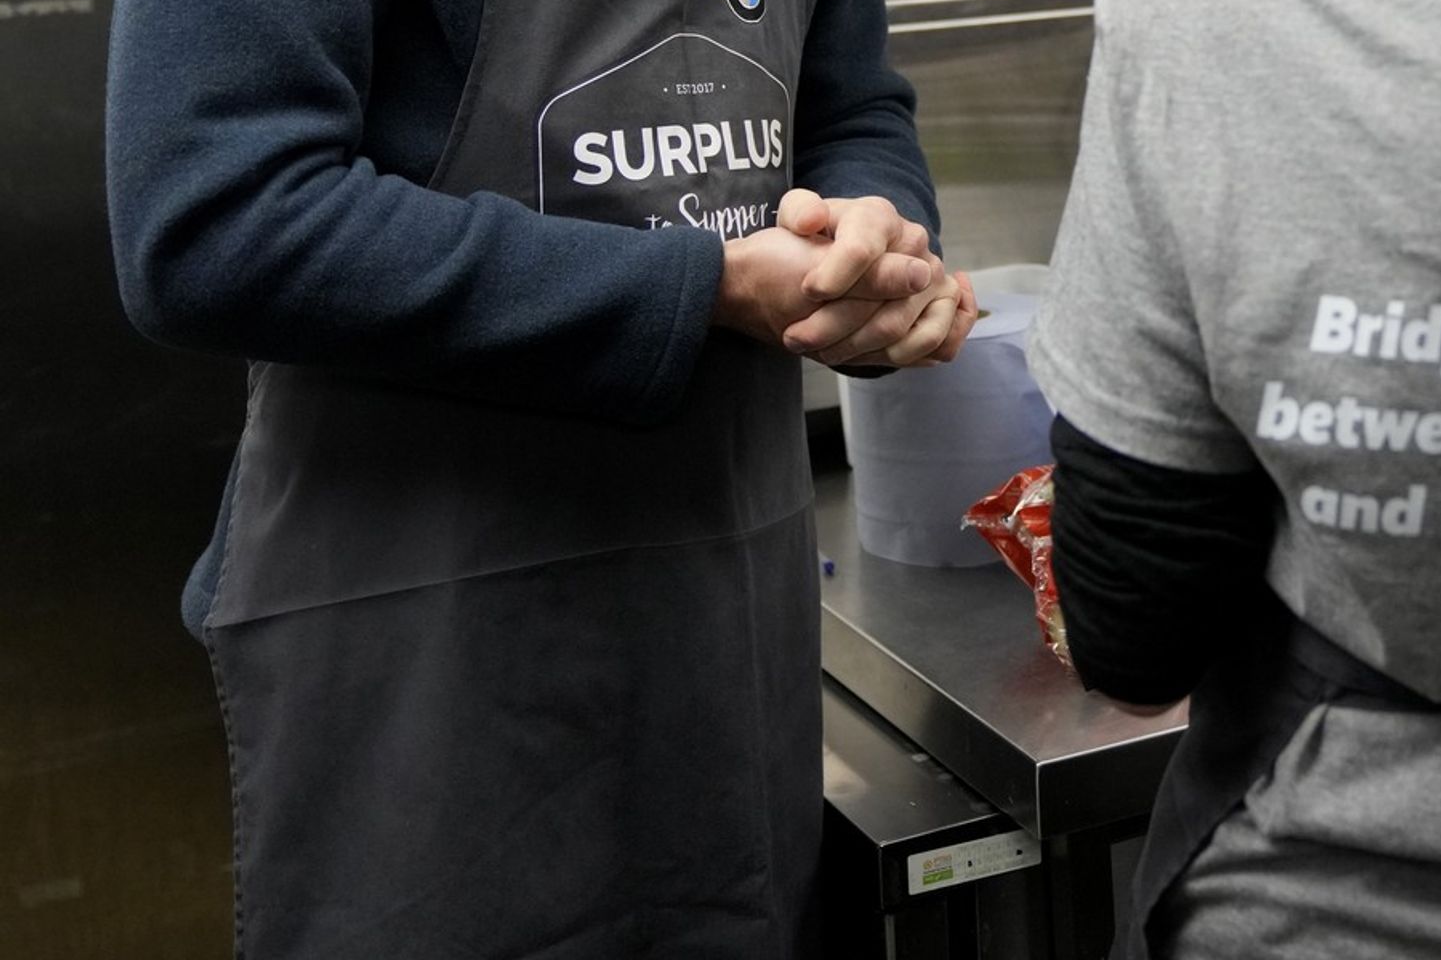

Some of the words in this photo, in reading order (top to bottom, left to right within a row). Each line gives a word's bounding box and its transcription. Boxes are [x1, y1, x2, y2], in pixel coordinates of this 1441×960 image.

[572, 118, 783, 186] SURPLUS
[678, 192, 769, 243] Supper
[1301, 485, 1427, 537] and
